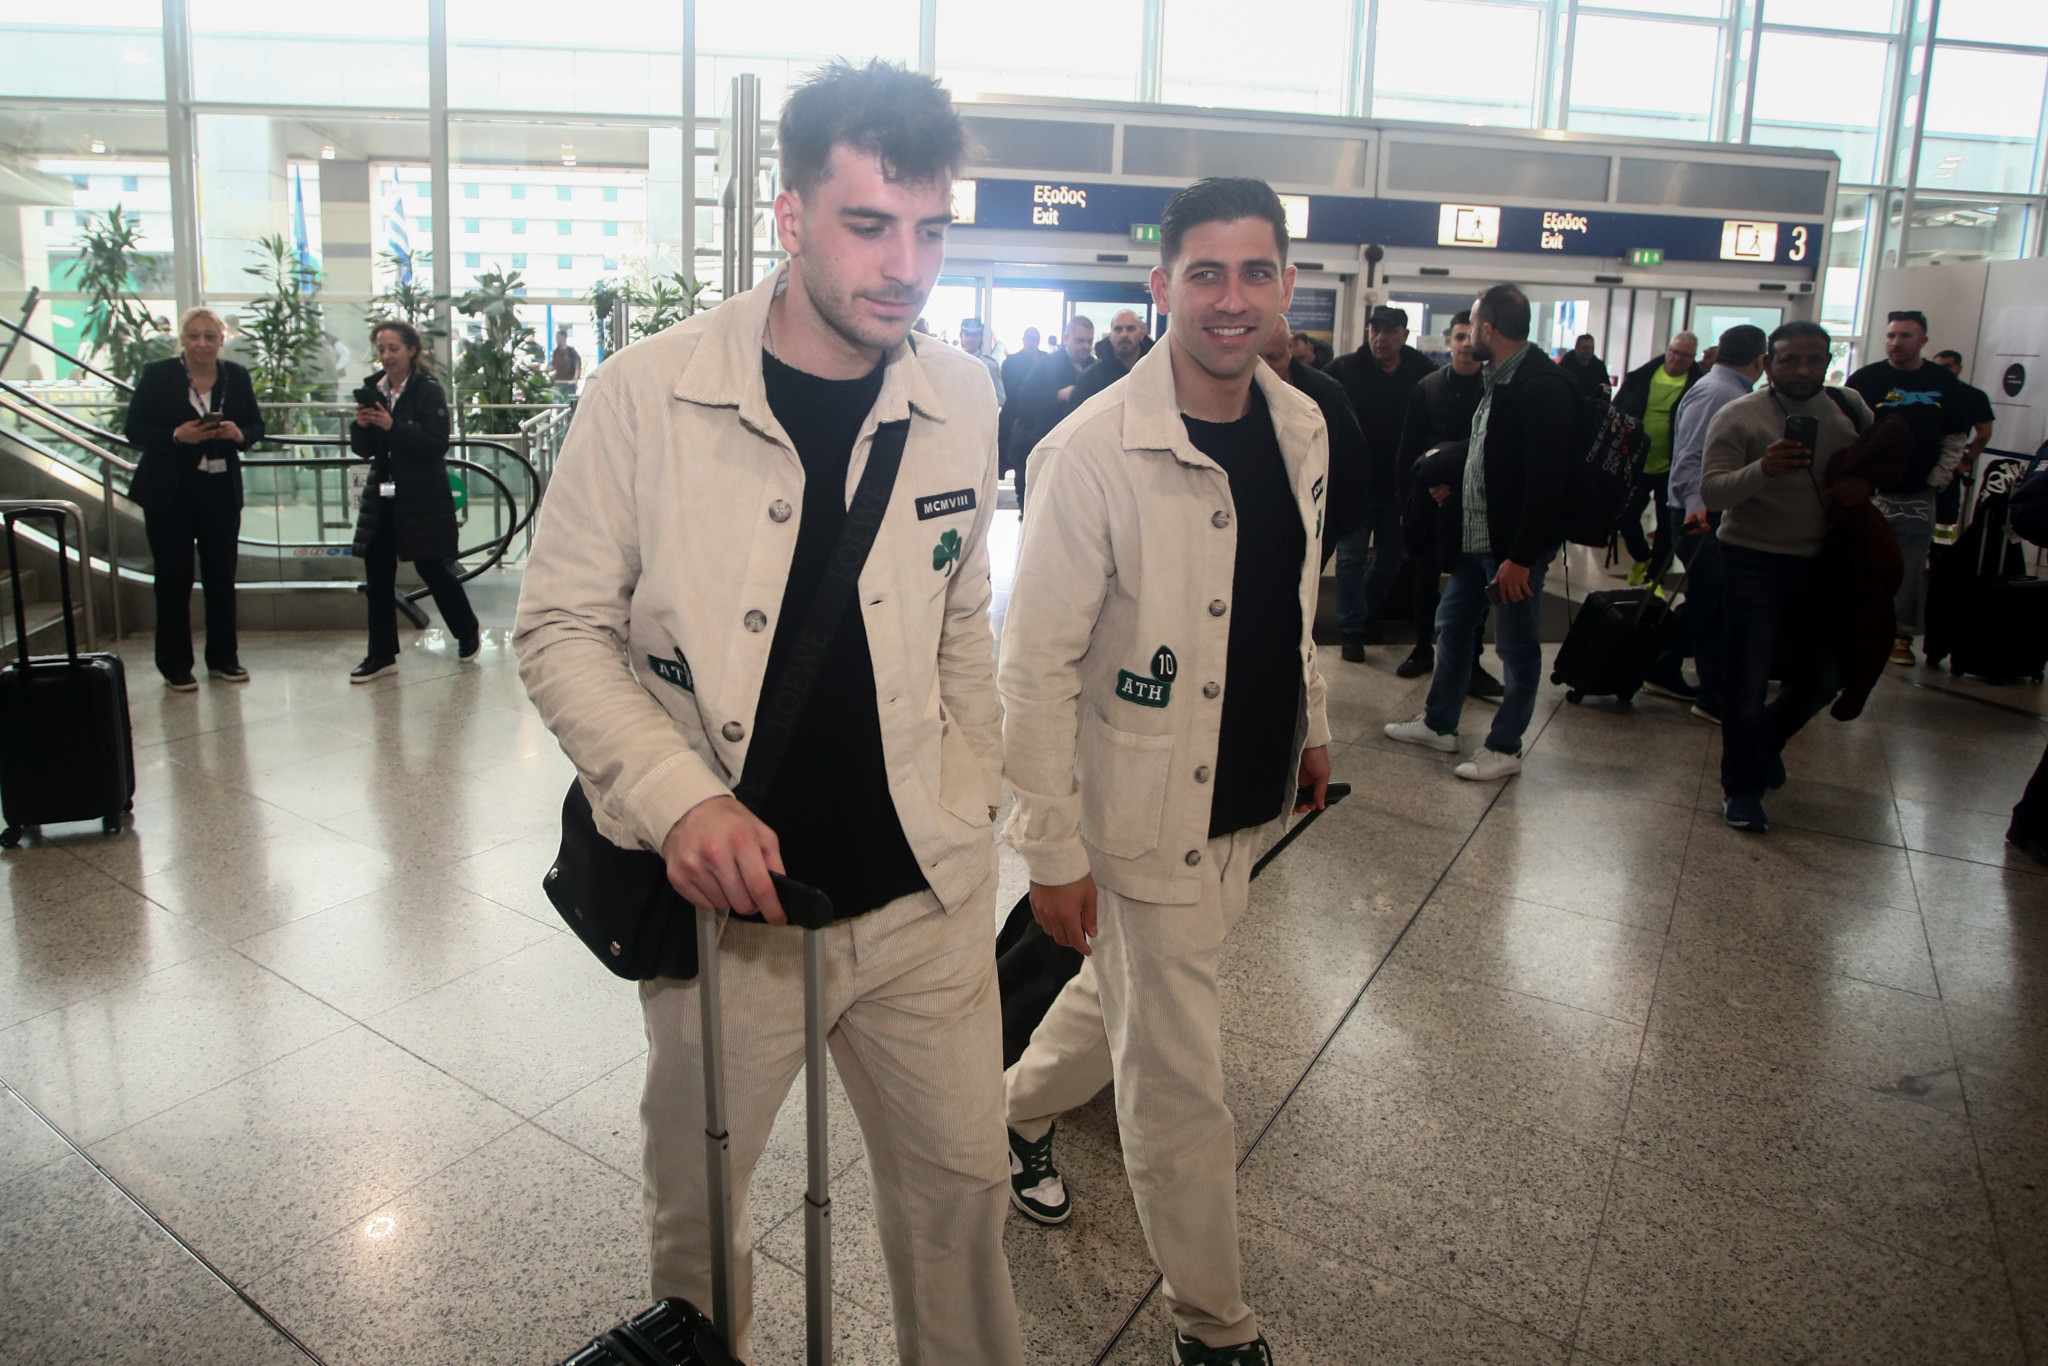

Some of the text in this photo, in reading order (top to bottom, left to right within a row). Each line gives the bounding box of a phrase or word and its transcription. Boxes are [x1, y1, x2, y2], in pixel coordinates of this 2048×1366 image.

[1033, 185, 1087, 208] Εξοδος
[1032, 206, 1060, 226] Exit
[1542, 211, 1588, 234] Εξοδος
[1541, 231, 1564, 250] Exit
[1789, 225, 1808, 261] 3
[923, 495, 968, 514] MCMVIII
[659, 662, 684, 682] AT
[1159, 654, 1174, 675] 10
[1121, 677, 1164, 700] ATH
